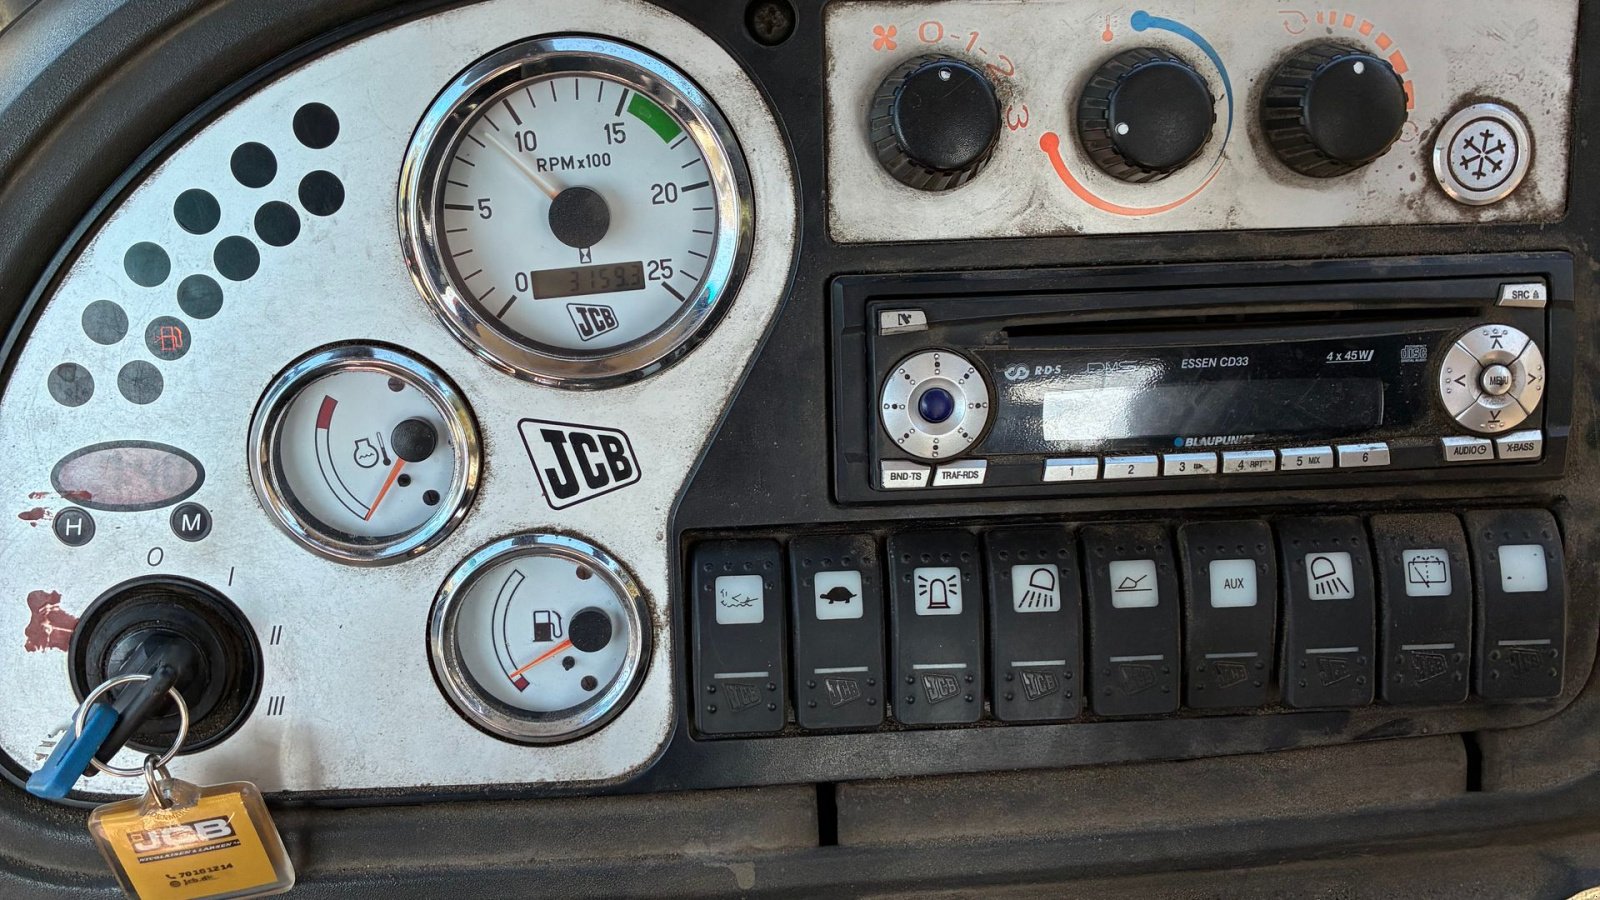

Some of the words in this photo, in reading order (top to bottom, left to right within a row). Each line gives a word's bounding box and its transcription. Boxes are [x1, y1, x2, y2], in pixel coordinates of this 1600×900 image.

[603, 122, 627, 145] 15
[514, 130, 538, 153] 10
[650, 182, 679, 205] 20
[478, 198, 493, 220] 5
[648, 259, 674, 281] 25
[514, 271, 529, 293] 0
[1511, 289, 1530, 300] SRC
[575, 306, 616, 338] JCB
[1326, 351, 1334, 361] 4
[1181, 356, 1217, 369] ESSEN
[1218, 356, 1250, 368] CD33
[1489, 376, 1509, 386] MENU
[1453, 445, 1477, 455] AUDIO
[1506, 442, 1535, 452] X-BASS
[1296, 455, 1303, 466] 5
[1308, 455, 1321, 465] MIX
[1362, 452, 1369, 463] 6
[539, 428, 634, 500] JCB
[1127, 464, 1134, 475] 2
[1178, 461, 1186, 472] 3
[1237, 459, 1244, 470] 4
[1249, 460, 1263, 468] RPT
[941, 470, 979, 480] TRAF-RDS
[1069, 466, 1075, 477] 1
[65, 518, 82, 536] H
[181, 513, 201, 532] M
[1223, 578, 1245, 590] AUX
[134, 818, 232, 852] JCB
